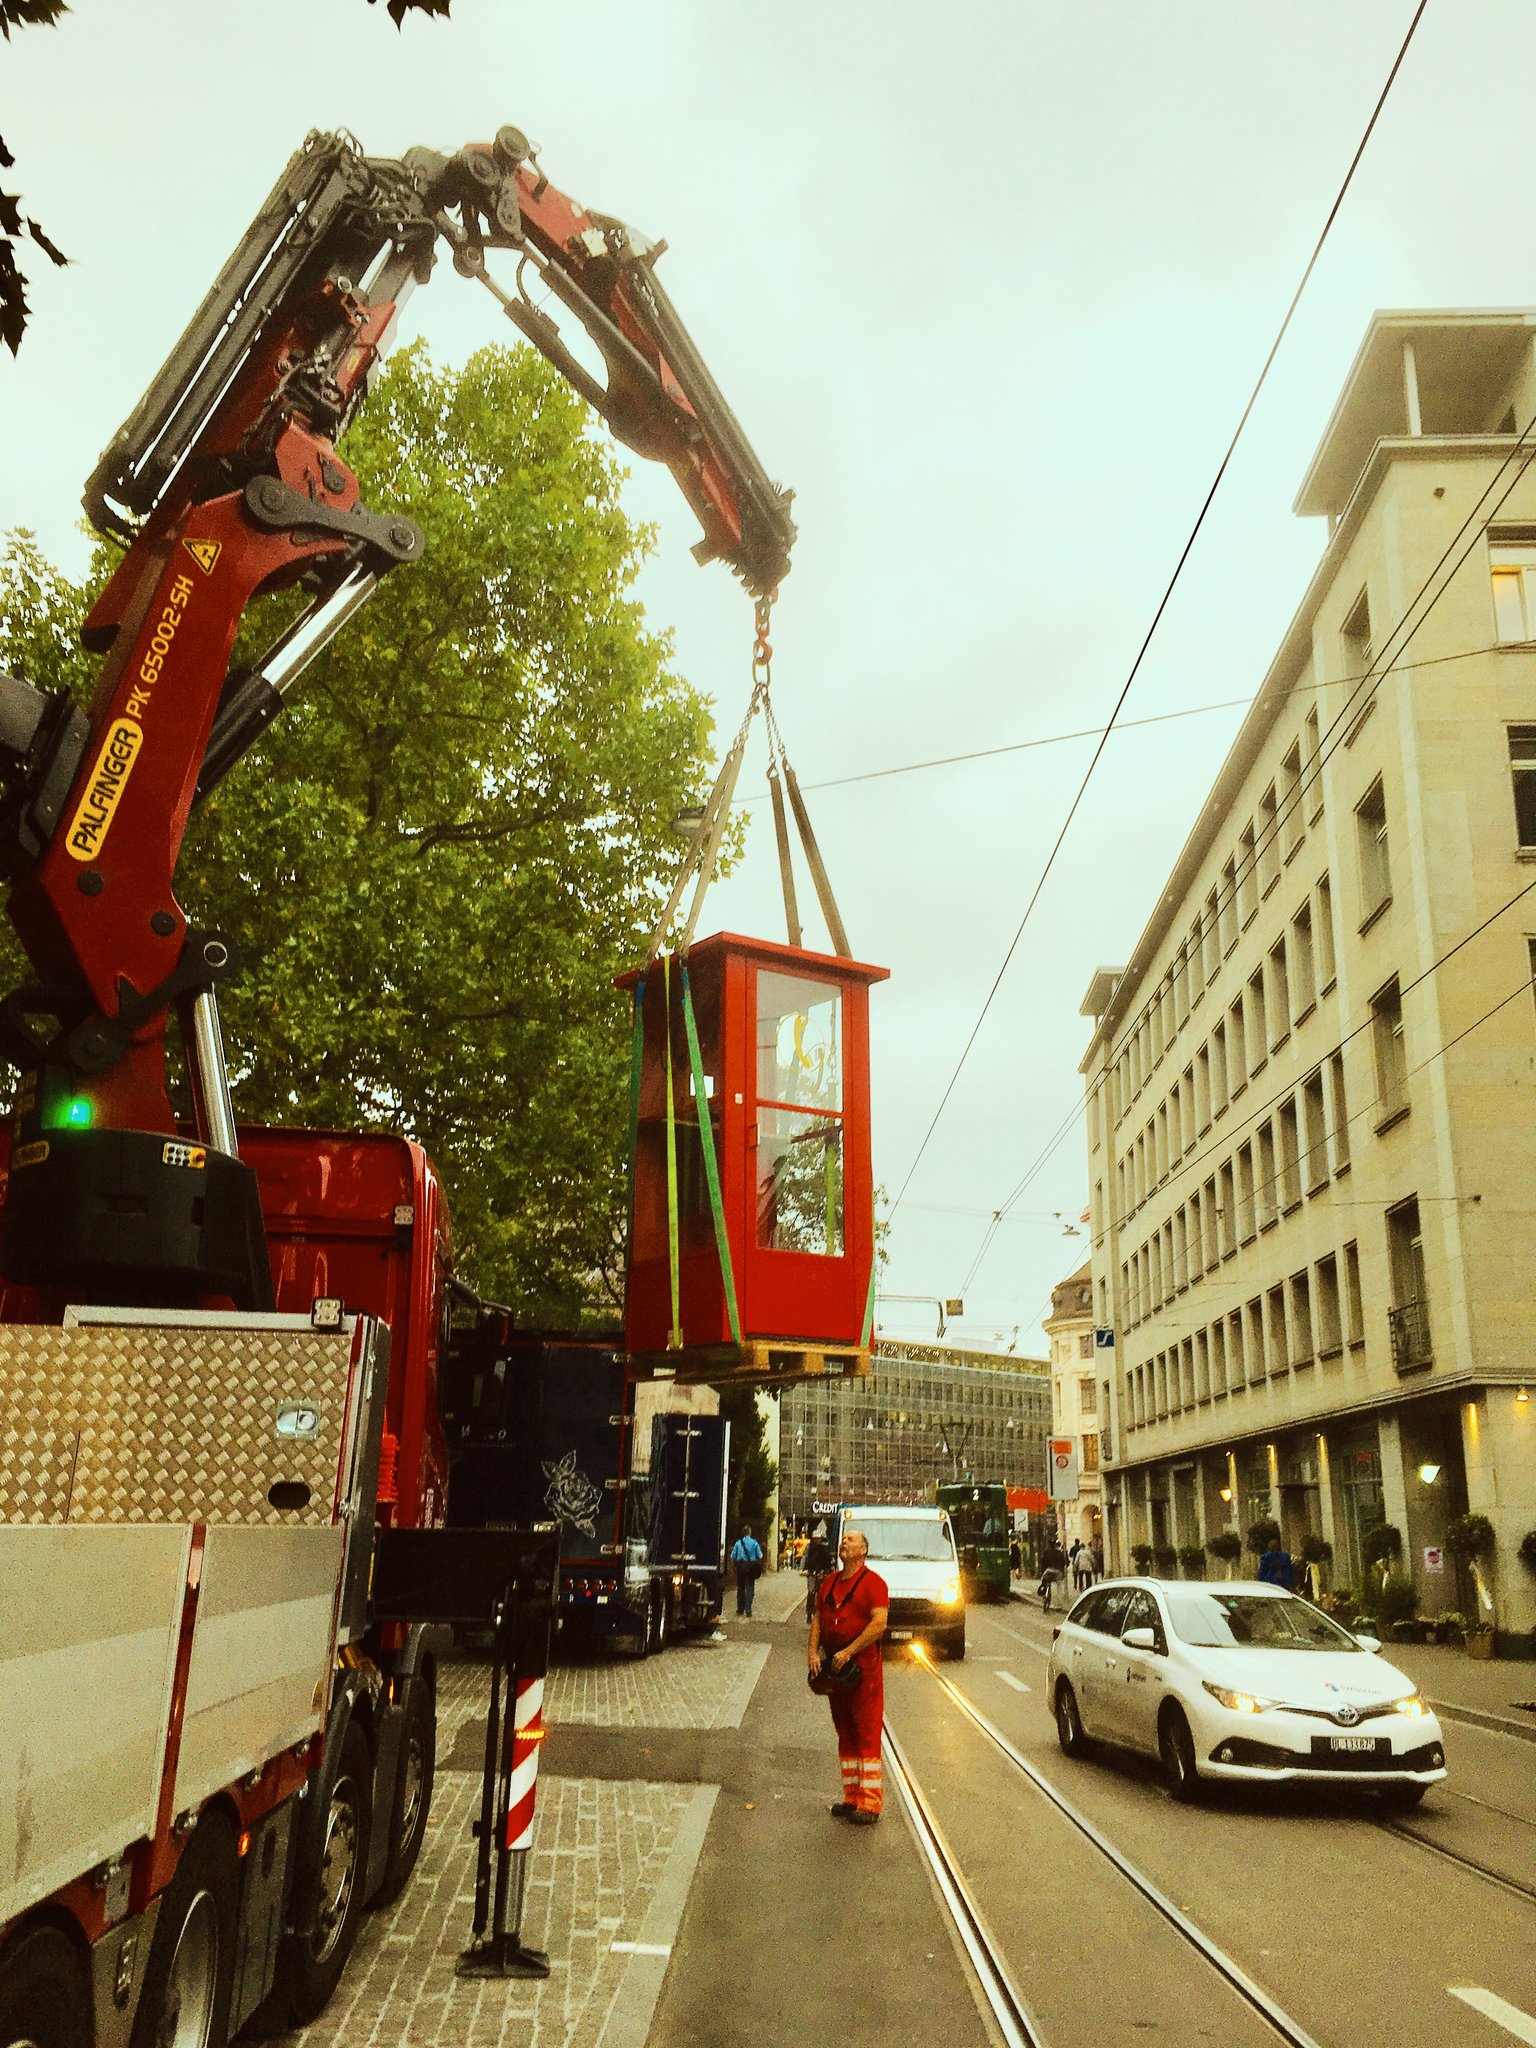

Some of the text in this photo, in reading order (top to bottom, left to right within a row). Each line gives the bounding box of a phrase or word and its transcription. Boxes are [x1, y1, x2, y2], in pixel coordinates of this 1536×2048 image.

[125, 684, 151, 719] PK
[72, 727, 138, 854] PALFINGER
[972, 1489, 980, 1501] 2
